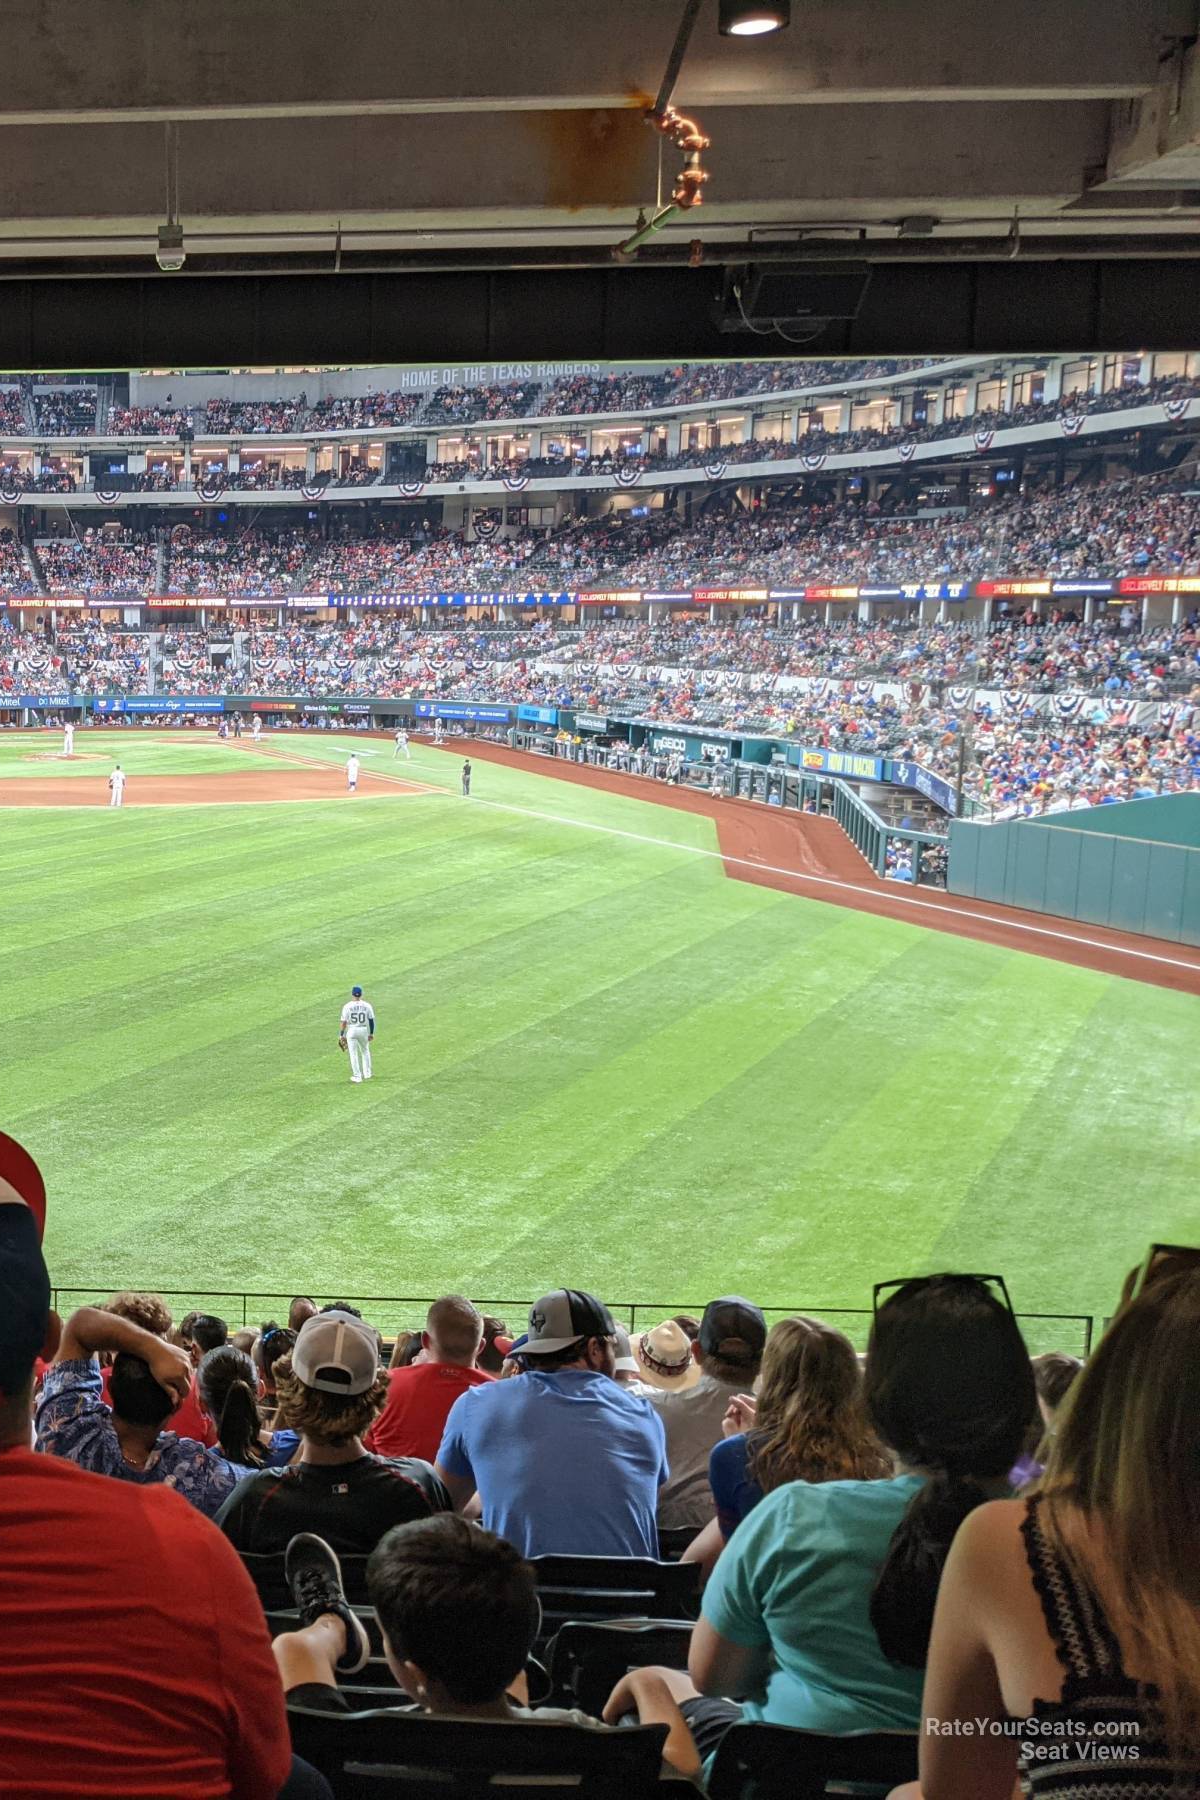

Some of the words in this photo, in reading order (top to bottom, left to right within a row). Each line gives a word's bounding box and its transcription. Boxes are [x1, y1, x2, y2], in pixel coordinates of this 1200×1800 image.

[402, 370, 438, 387] HOME
[443, 368, 459, 384] OF
[464, 366, 486, 382] THE
[492, 364, 532, 380] TEXAS
[537, 363, 600, 377] RANGERS
[0, 698, 20, 706] Mitel
[49, 697, 70, 705] Mitel
[662, 736, 686, 750] GEICO
[351, 1013, 365, 1023] 50
